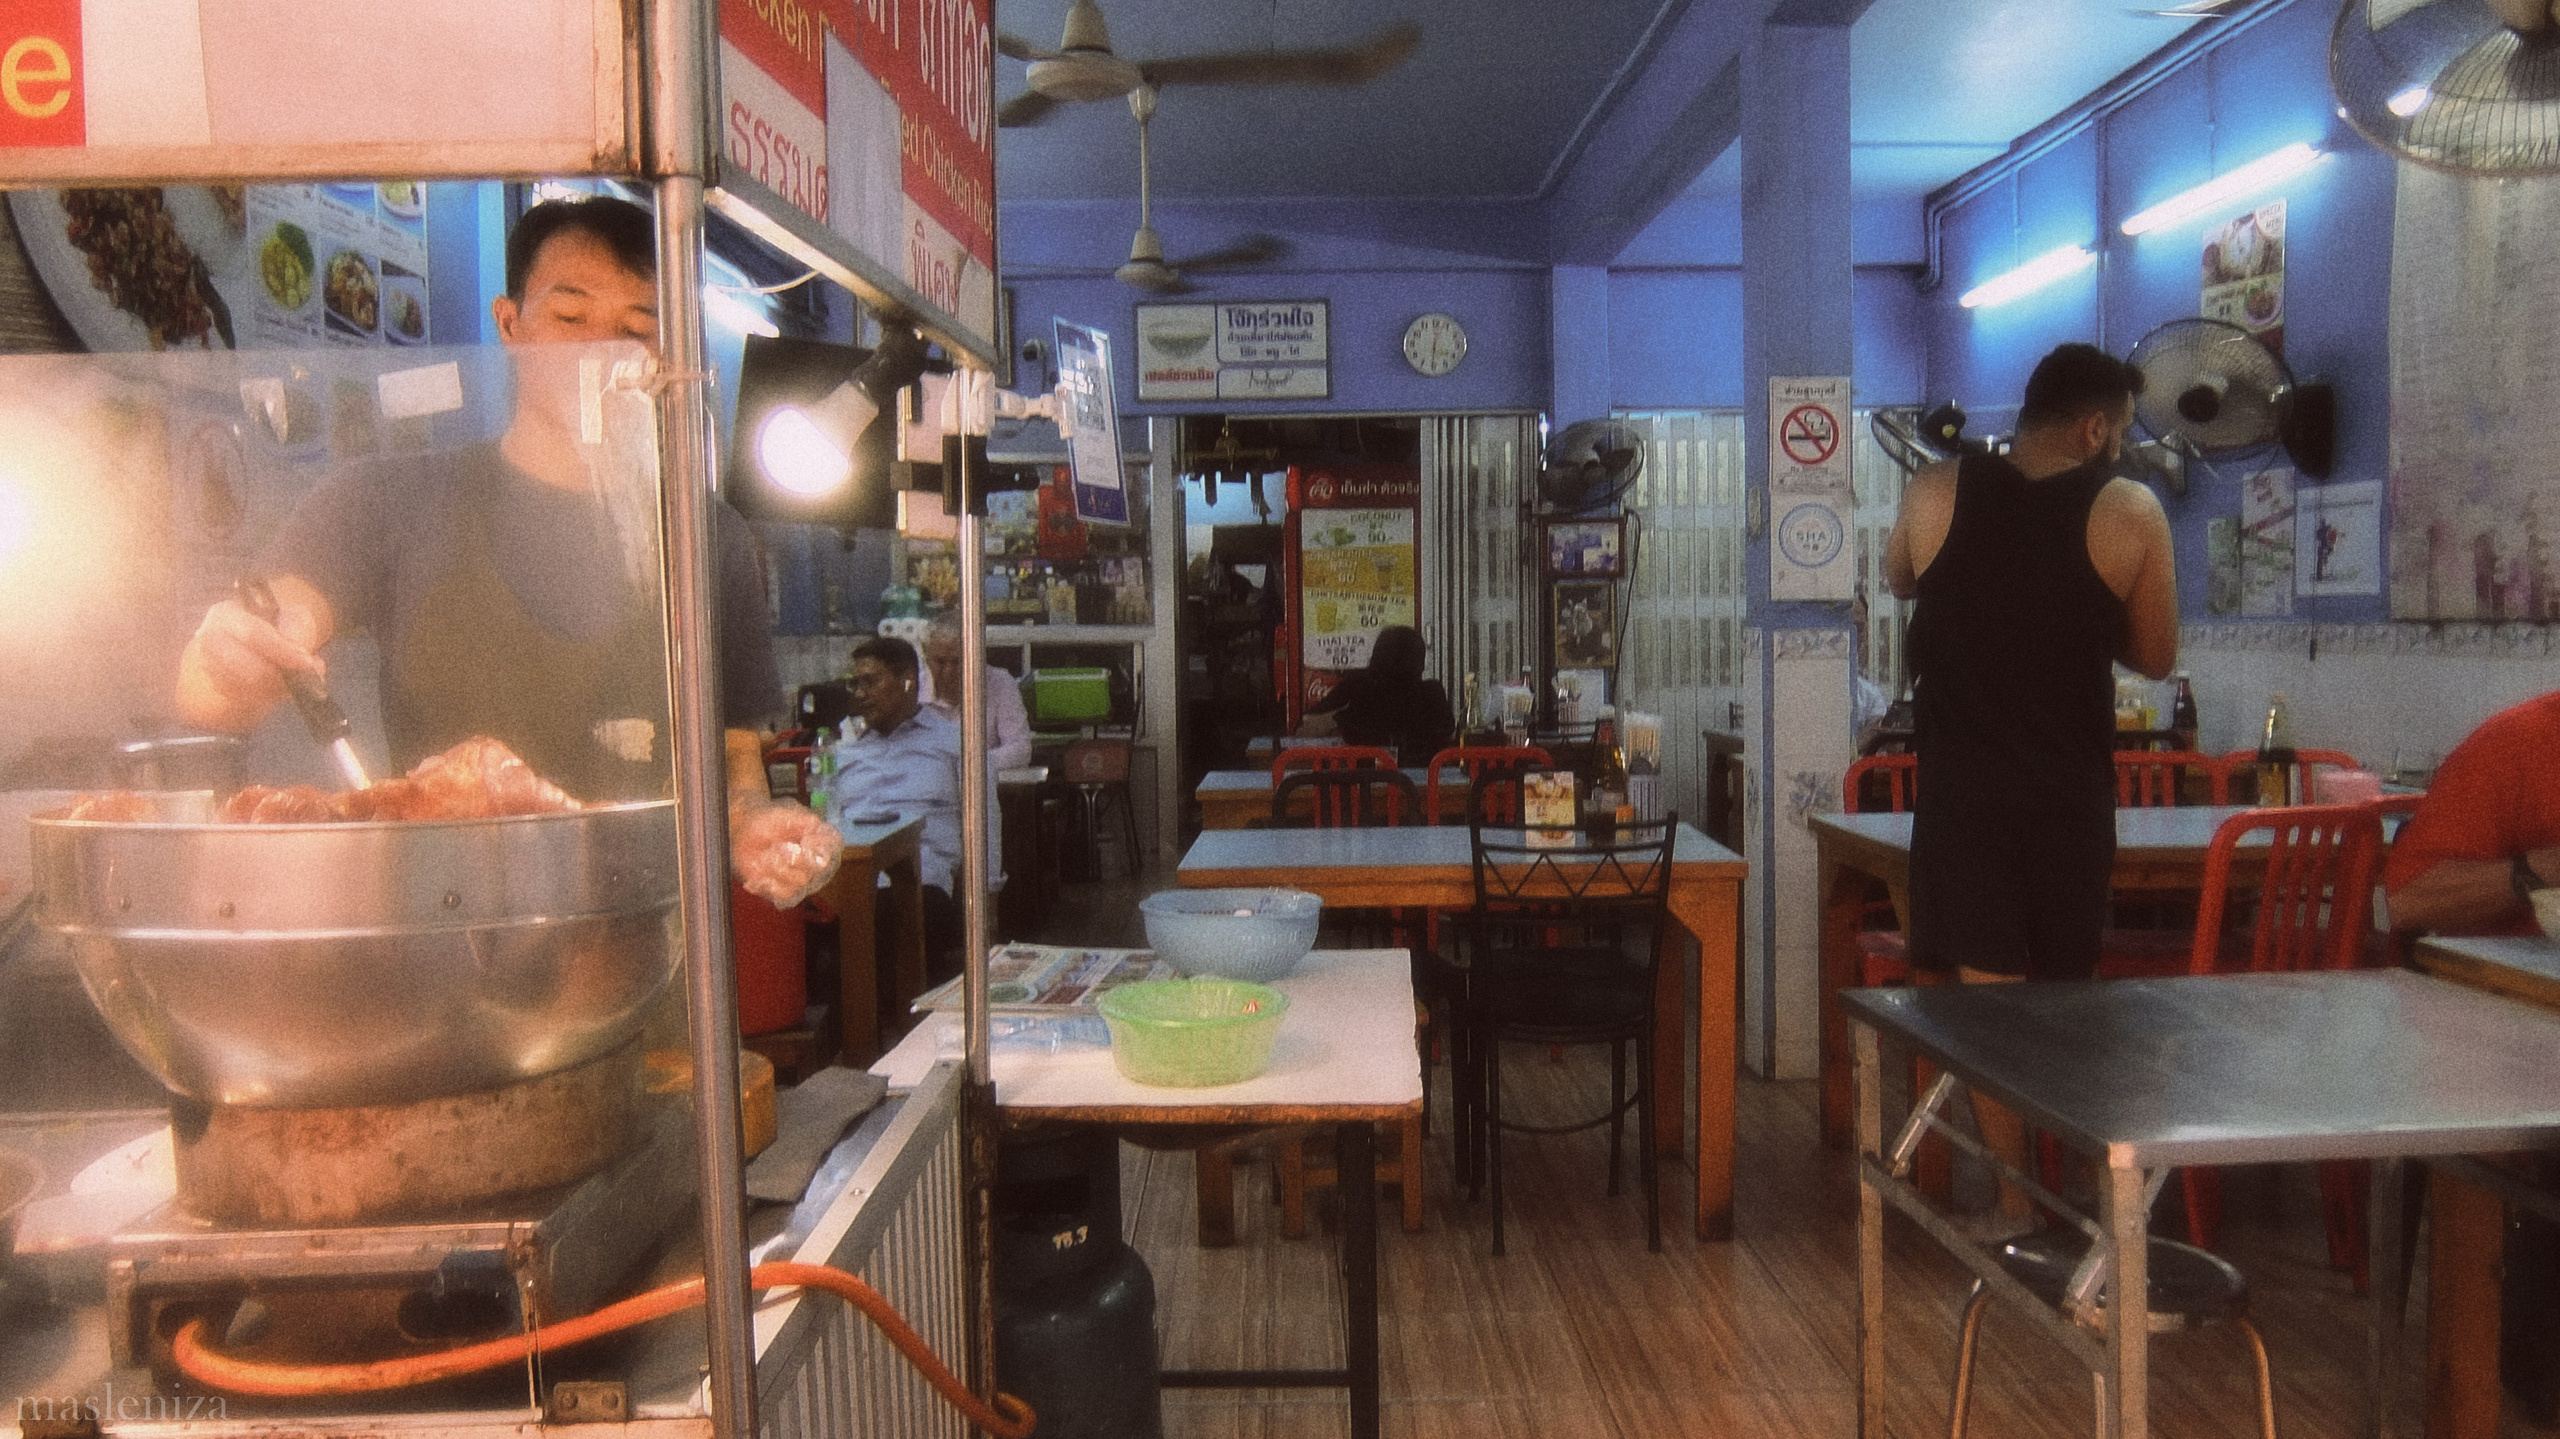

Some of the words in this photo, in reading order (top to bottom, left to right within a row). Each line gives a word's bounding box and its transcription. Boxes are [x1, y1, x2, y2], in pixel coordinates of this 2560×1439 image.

[0, 35, 72, 119] e
[923, 124, 972, 218] Chicken
[1317, 637, 1342, 647] THAI
[1346, 636, 1365, 646] TEA
